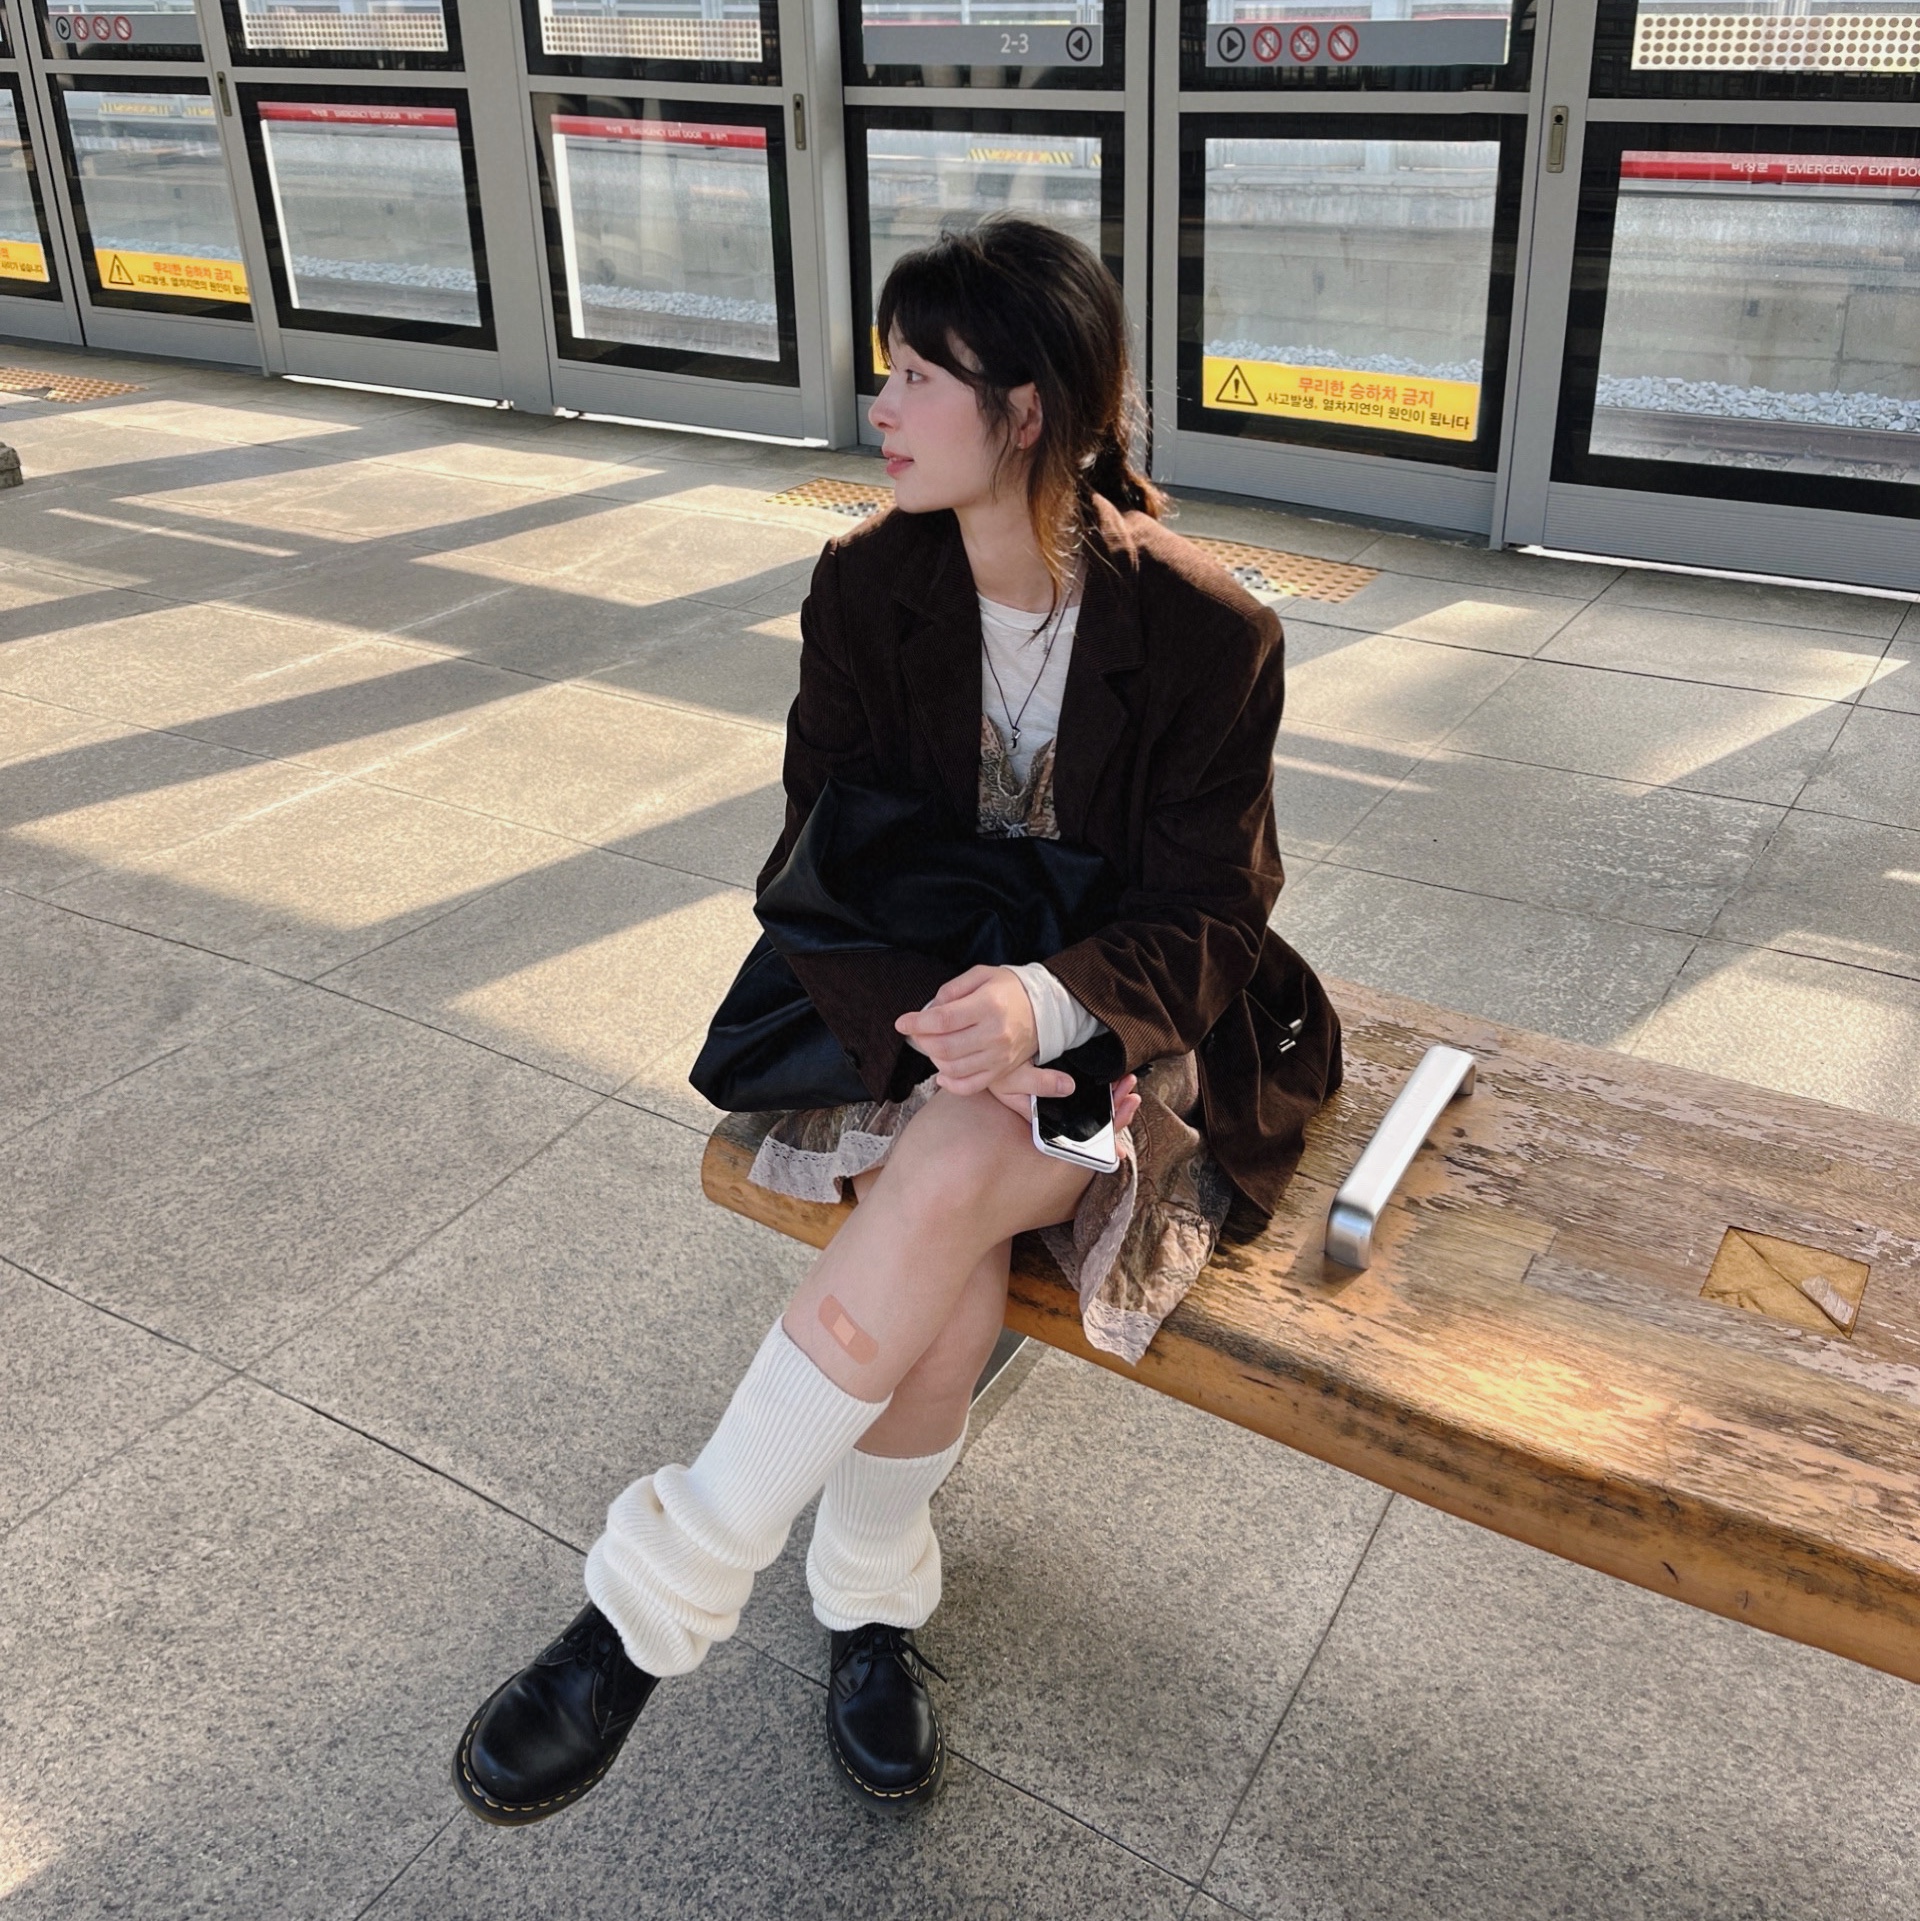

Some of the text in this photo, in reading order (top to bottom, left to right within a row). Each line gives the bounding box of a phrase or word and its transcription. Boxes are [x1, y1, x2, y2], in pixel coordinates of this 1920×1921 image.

[1000, 33, 1029, 54] 2-3
[1786, 163, 1920, 178] EMERGENCY EXIT DO
[153, 261, 182, 276] 무리한
[214, 267, 234, 283] 금지
[1298, 377, 1435, 408] 무리한 승하차 금지
[1266, 391, 1470, 431] 사고발생, 열차지연의 원인이 됩니다
